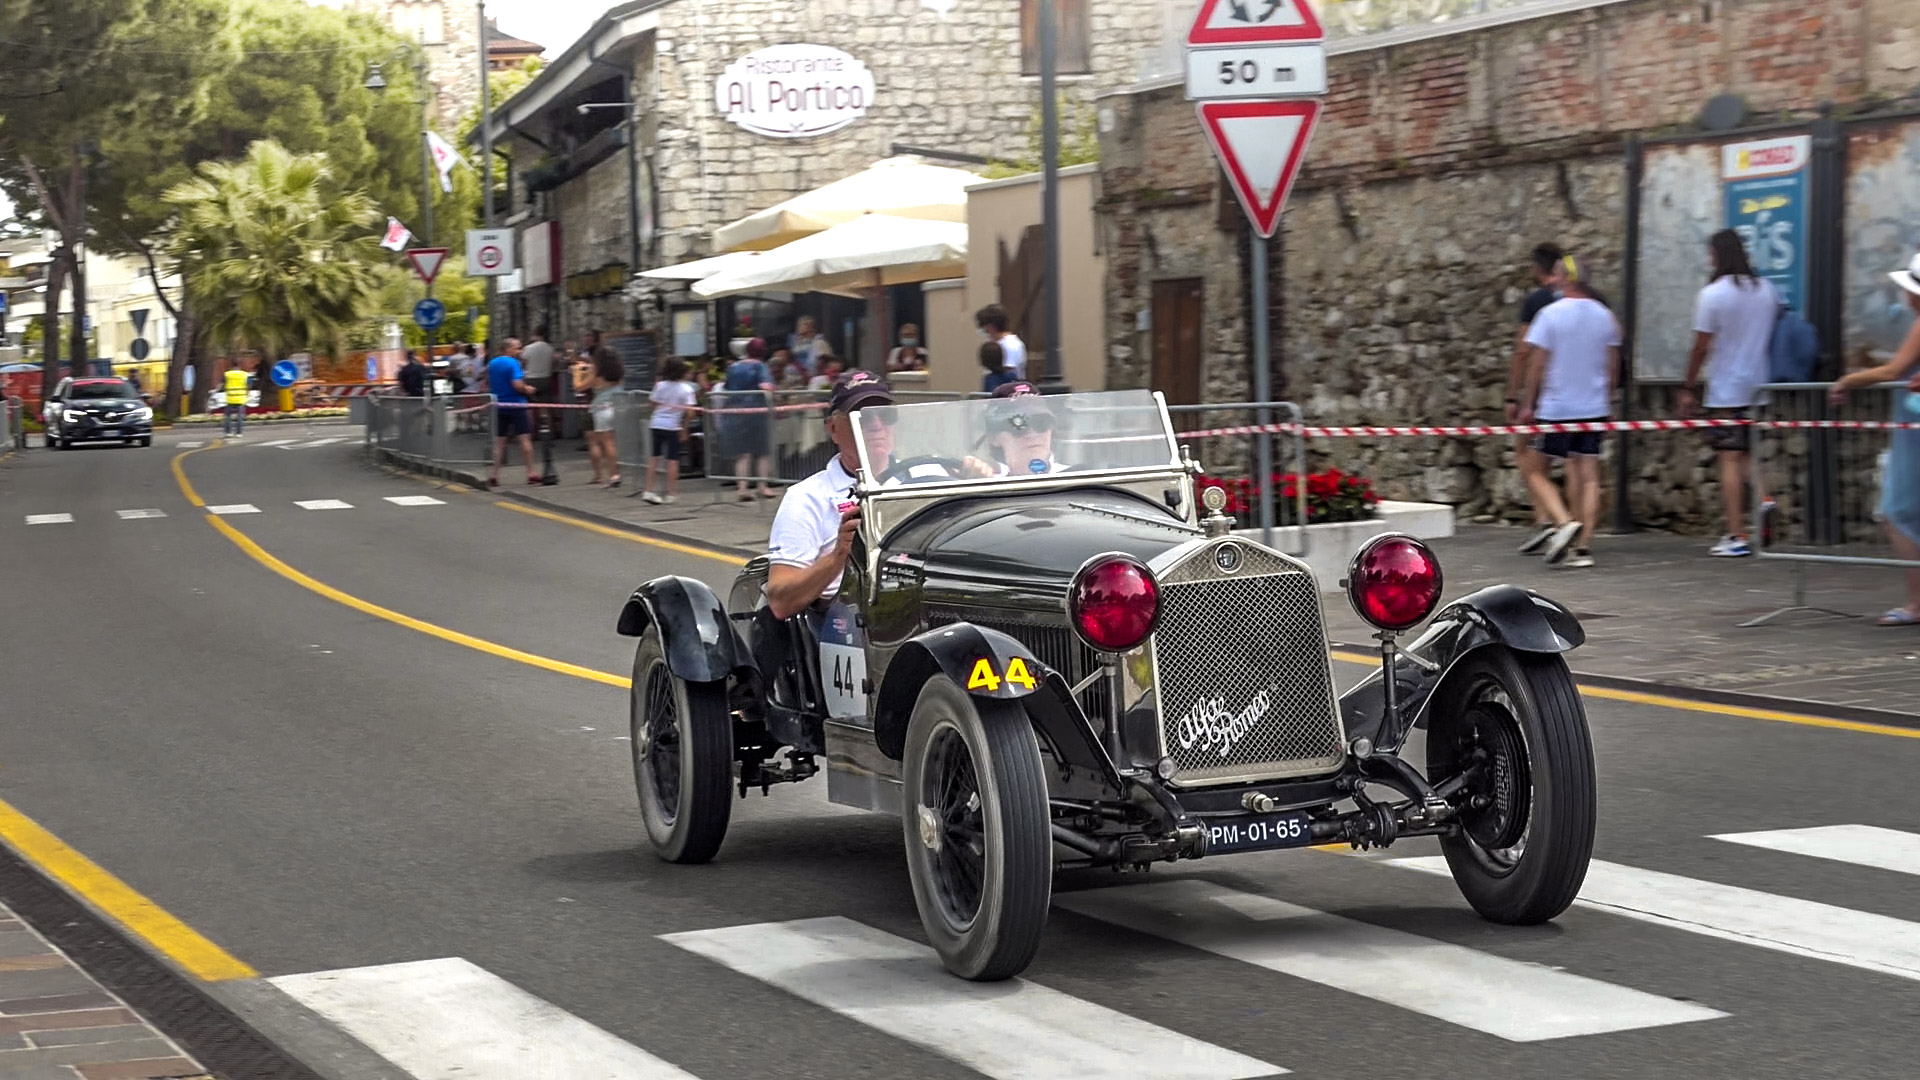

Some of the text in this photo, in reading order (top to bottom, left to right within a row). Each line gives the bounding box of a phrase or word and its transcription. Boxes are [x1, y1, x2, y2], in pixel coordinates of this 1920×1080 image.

[746, 56, 844, 75] Ristorante
[1220, 60, 1296, 85] 50 m
[728, 80, 864, 113] Al Portico
[833, 652, 854, 699] 44
[967, 657, 1036, 691] 44
[1179, 690, 1270, 757] Alfa Romeo
[1210, 819, 1301, 845] PM-01-65
